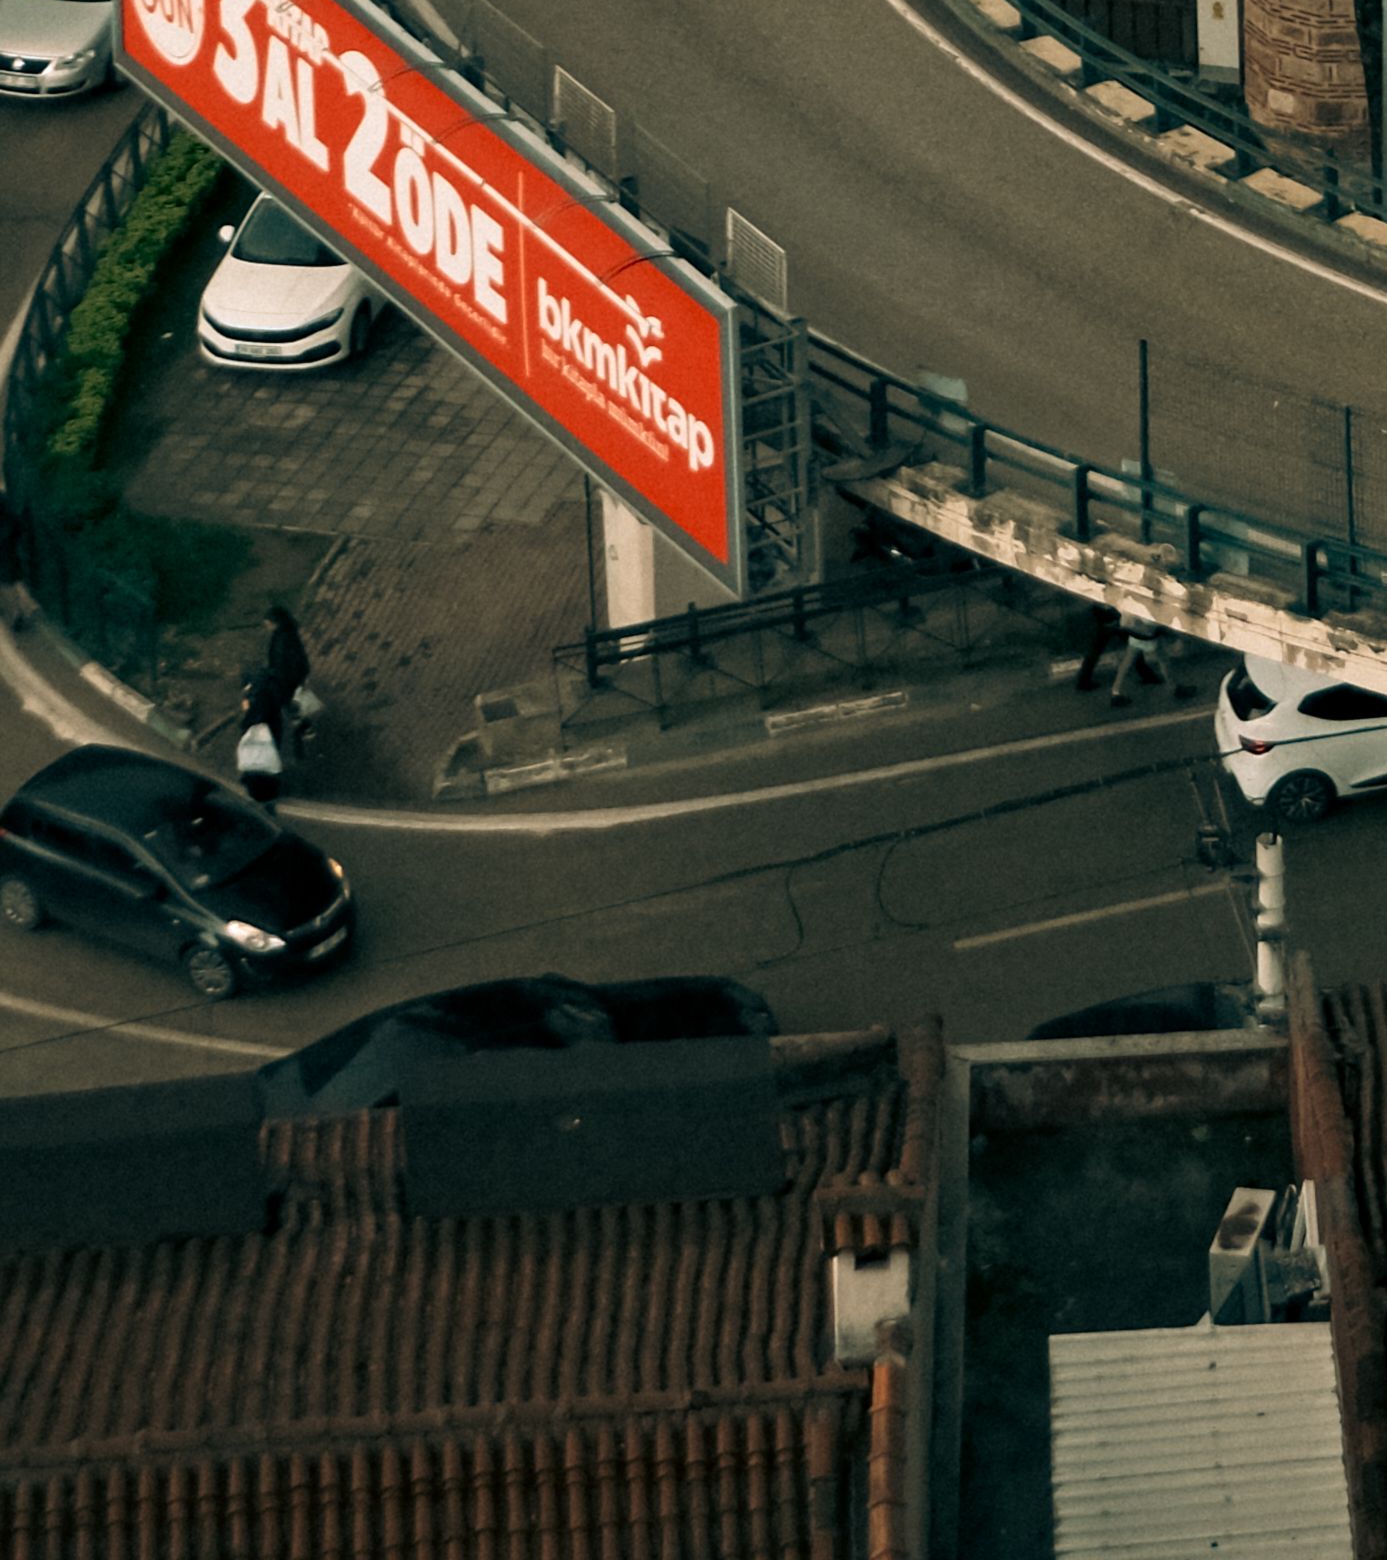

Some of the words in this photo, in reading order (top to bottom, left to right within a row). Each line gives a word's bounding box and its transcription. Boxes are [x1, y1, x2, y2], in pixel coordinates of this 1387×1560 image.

[261, 33, 330, 173] AL
[337, 49, 393, 226] 2
[393, 124, 508, 326] ÖDE
